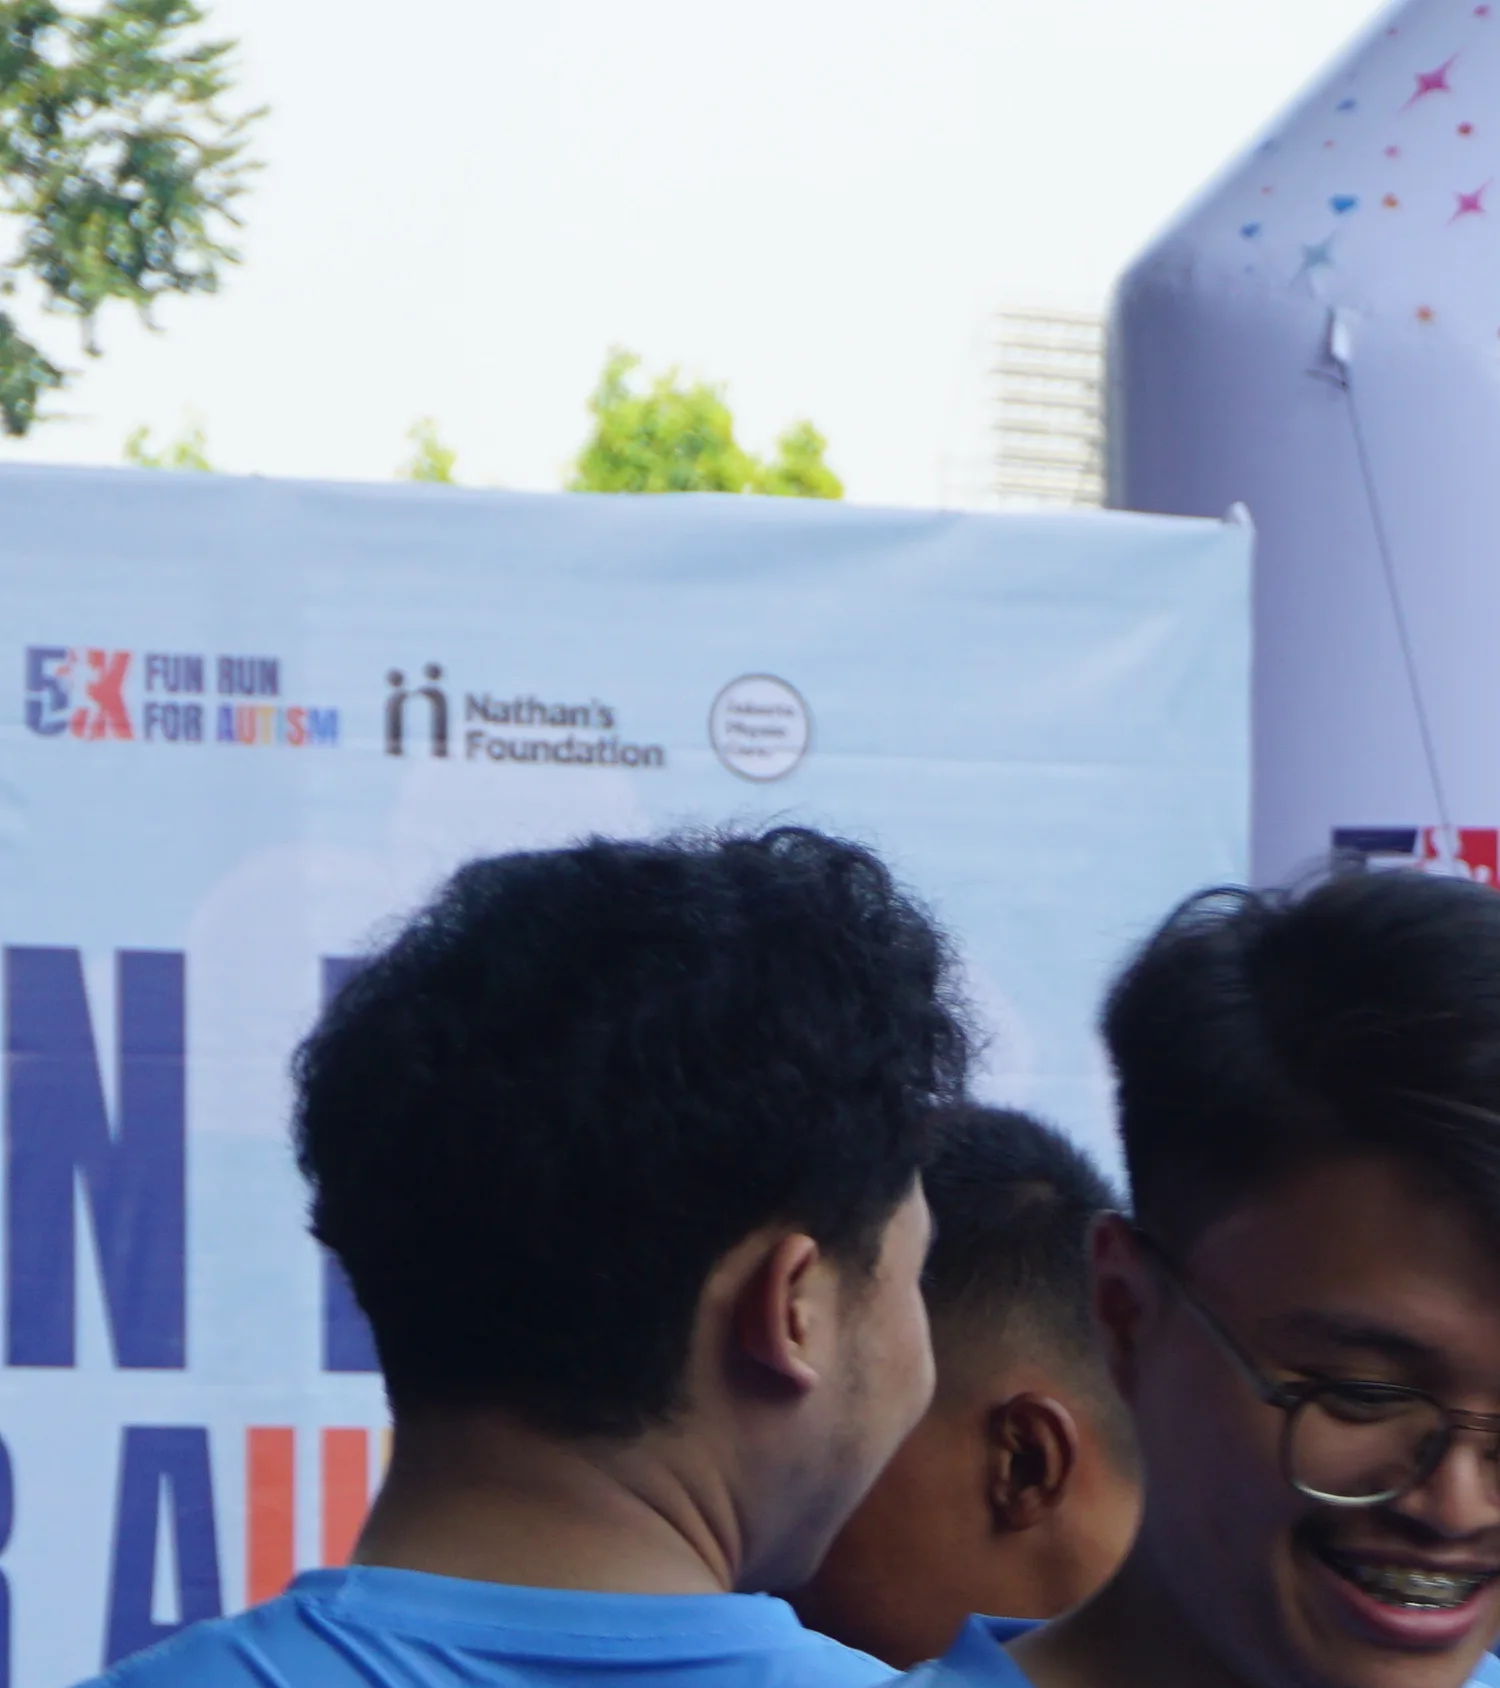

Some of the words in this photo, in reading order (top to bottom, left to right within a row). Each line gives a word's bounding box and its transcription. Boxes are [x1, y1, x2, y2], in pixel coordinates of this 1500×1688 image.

[144, 653, 205, 695] FUN
[217, 655, 280, 697] RUN
[144, 703, 205, 744] FOR
[216, 704, 339, 747] AUTISM
[465, 694, 614, 729] Nathan's
[465, 731, 665, 769] Foundation
